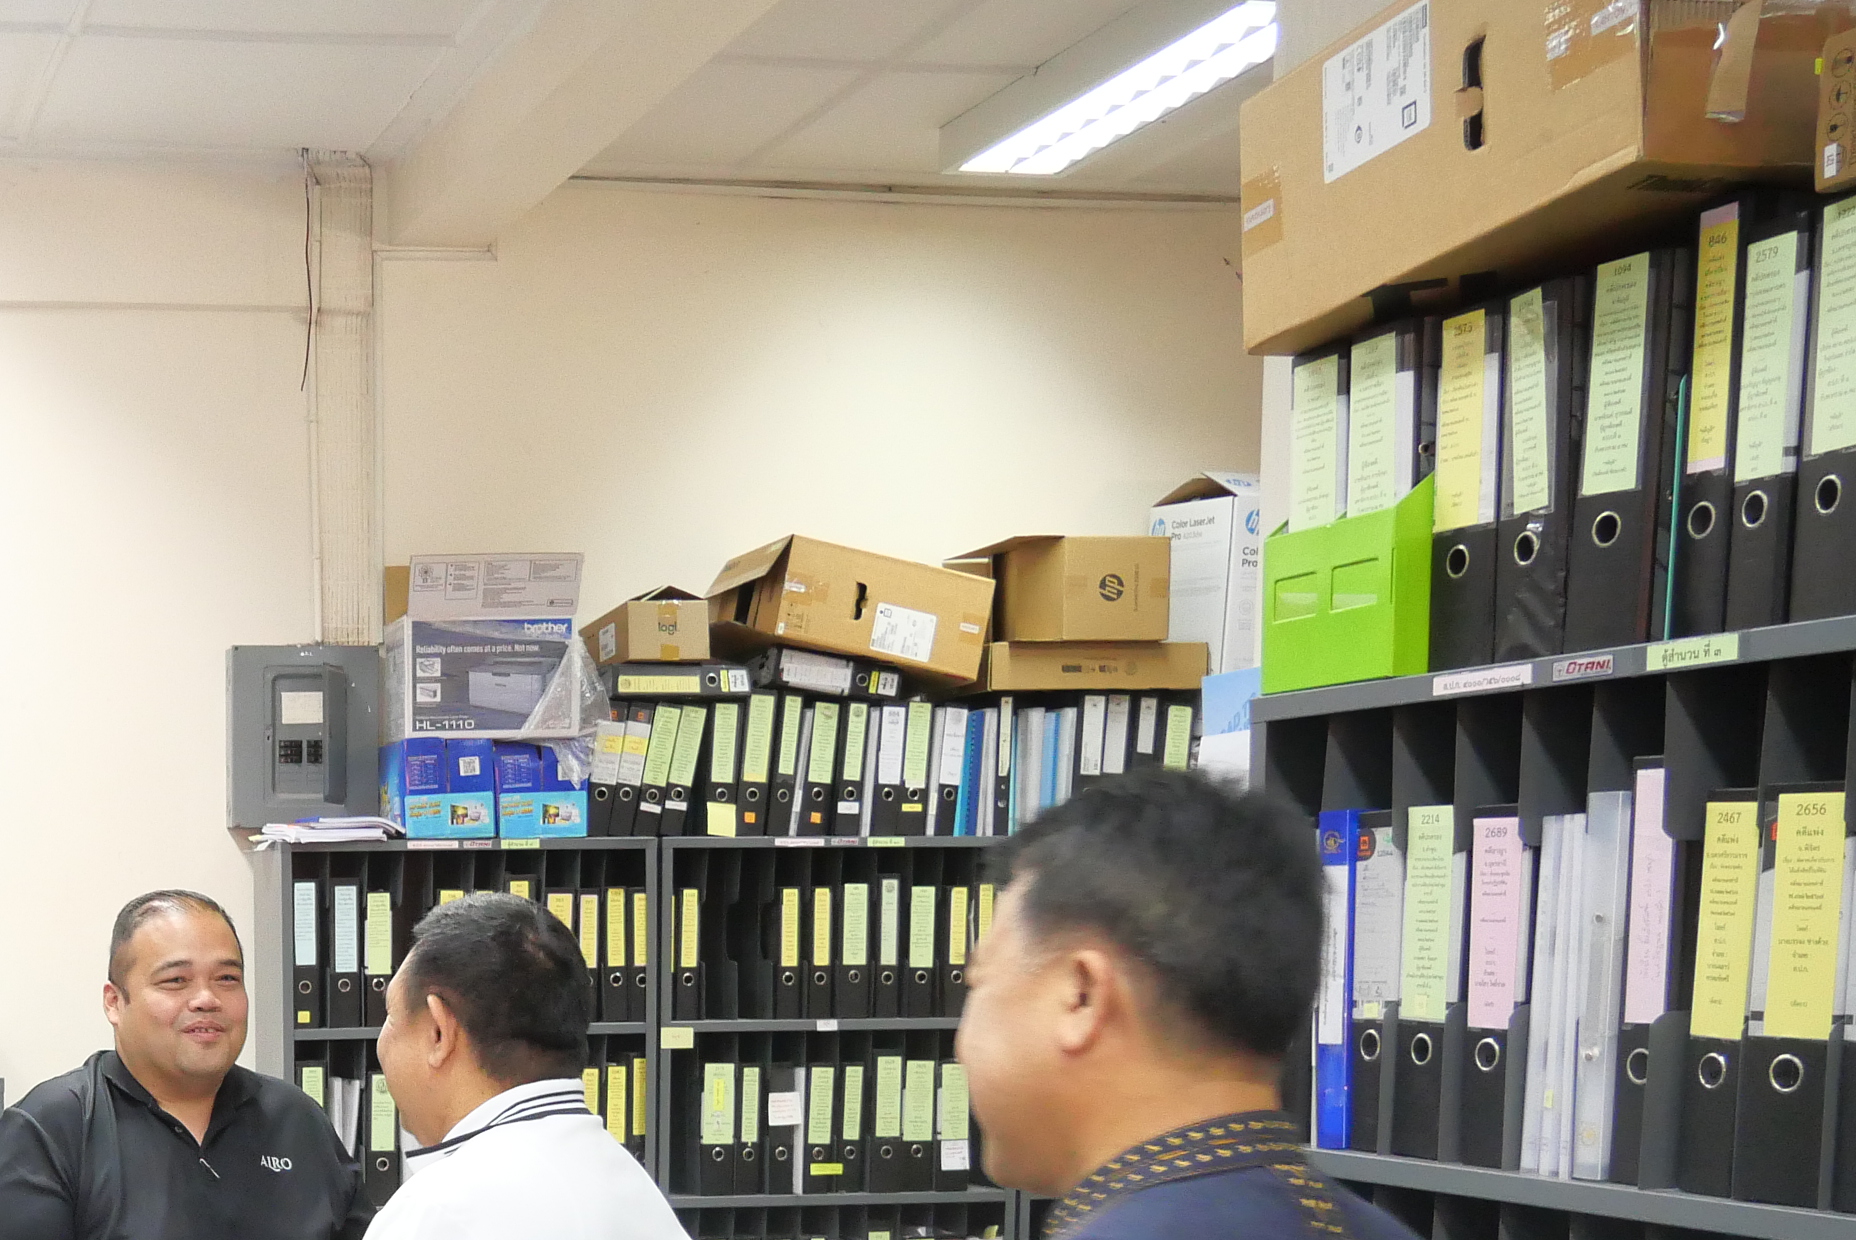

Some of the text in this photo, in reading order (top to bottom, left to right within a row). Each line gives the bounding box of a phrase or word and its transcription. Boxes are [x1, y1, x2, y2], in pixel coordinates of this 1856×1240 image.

[1755, 246, 1779, 263] 2579
[1171, 516, 1215, 529] Color LaserJet
[524, 621, 568, 635] brother
[416, 644, 445, 655] Reliability
[446, 644, 462, 653] often
[463, 645, 484, 653] comes
[496, 645, 513, 654] price.
[514, 644, 524, 652] Not
[1662, 647, 1700, 669] ตู้สำนวน
[1701, 640, 1711, 659] ที่
[1566, 658, 1611, 676] OTANI
[415, 719, 474, 730] HL-1110
[1796, 803, 1828, 816] 2656
[1421, 814, 1440, 825] 2214
[1717, 811, 1742, 824] 2467
[1485, 827, 1508, 839] 2689
[1796, 827, 1824, 837] คดีแพ่ง
[1717, 834, 1739, 845] คดีแพ่ง
[260, 1154, 293, 1172] ALRO
